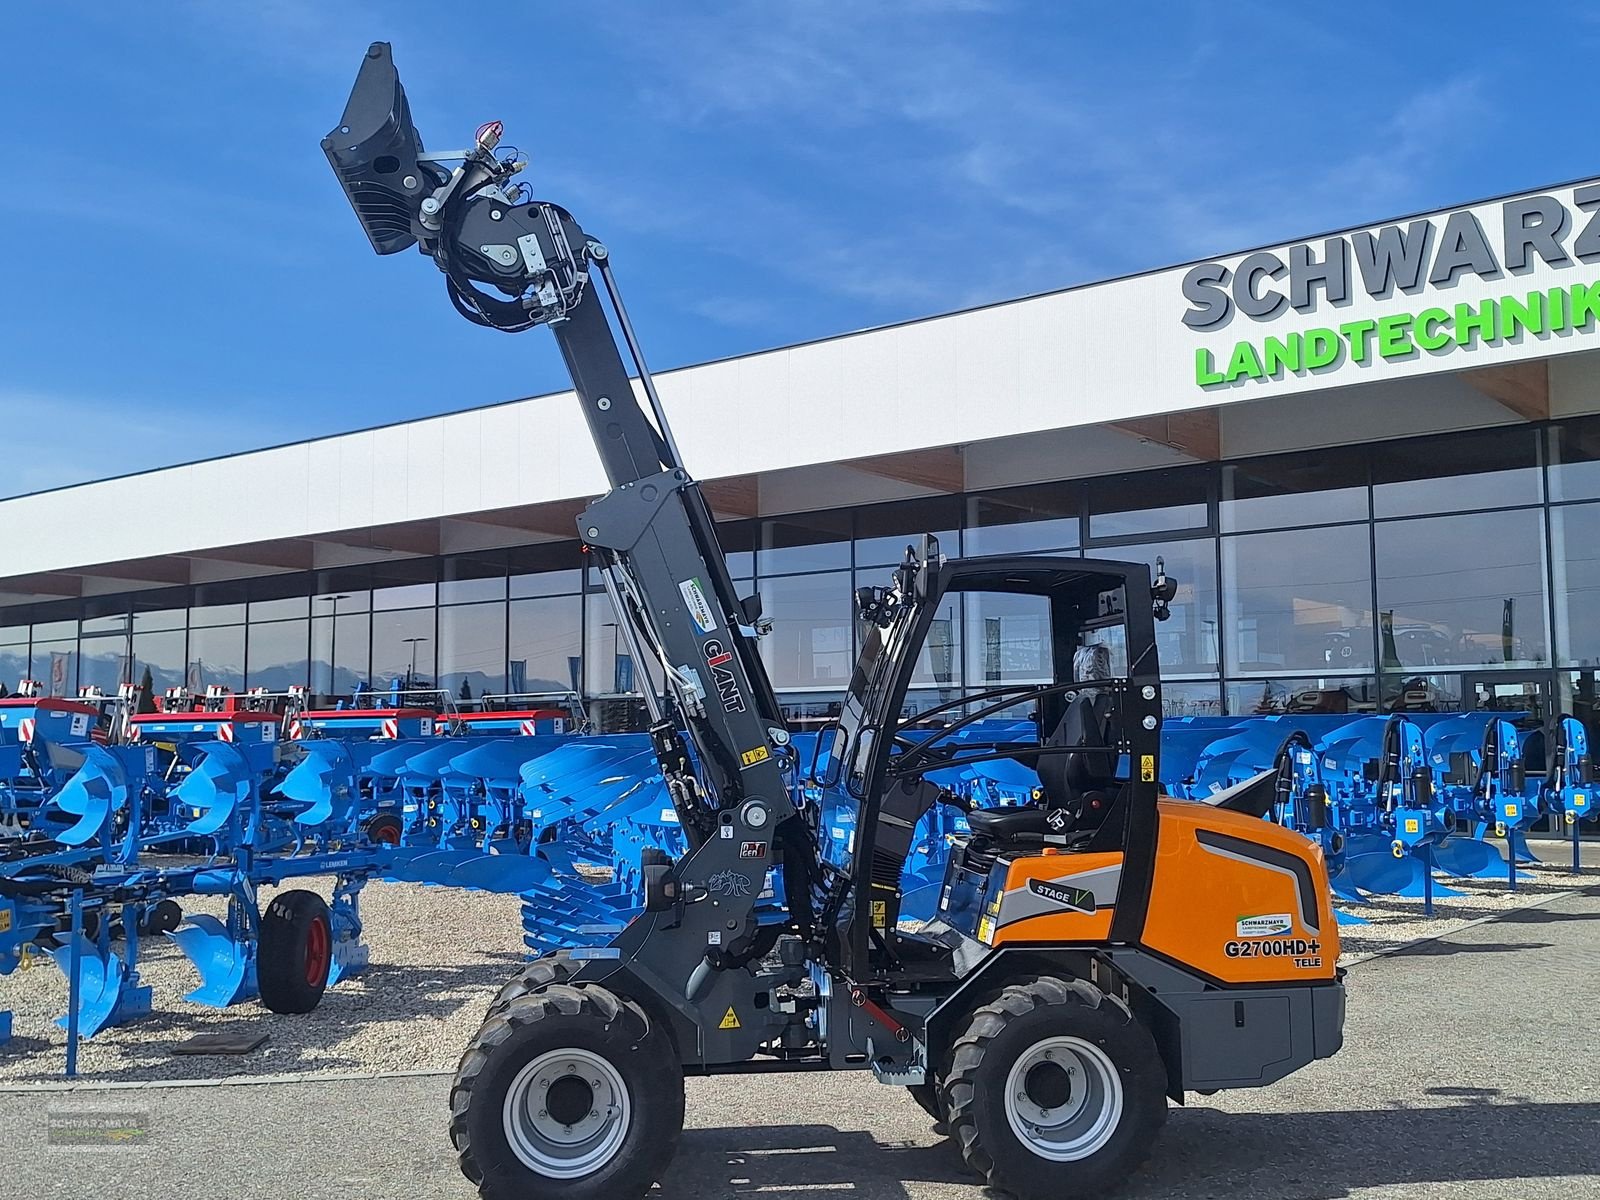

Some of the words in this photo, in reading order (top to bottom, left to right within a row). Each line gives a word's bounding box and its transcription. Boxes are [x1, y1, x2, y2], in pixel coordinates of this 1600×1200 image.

[1196, 280, 1600, 386] LANDTECHNIK
[702, 638, 747, 713] GIANT
[1036, 885, 1070, 902] STAGE
[1224, 938, 1321, 958] G2700HD+
[1293, 958, 1322, 968] TELE
